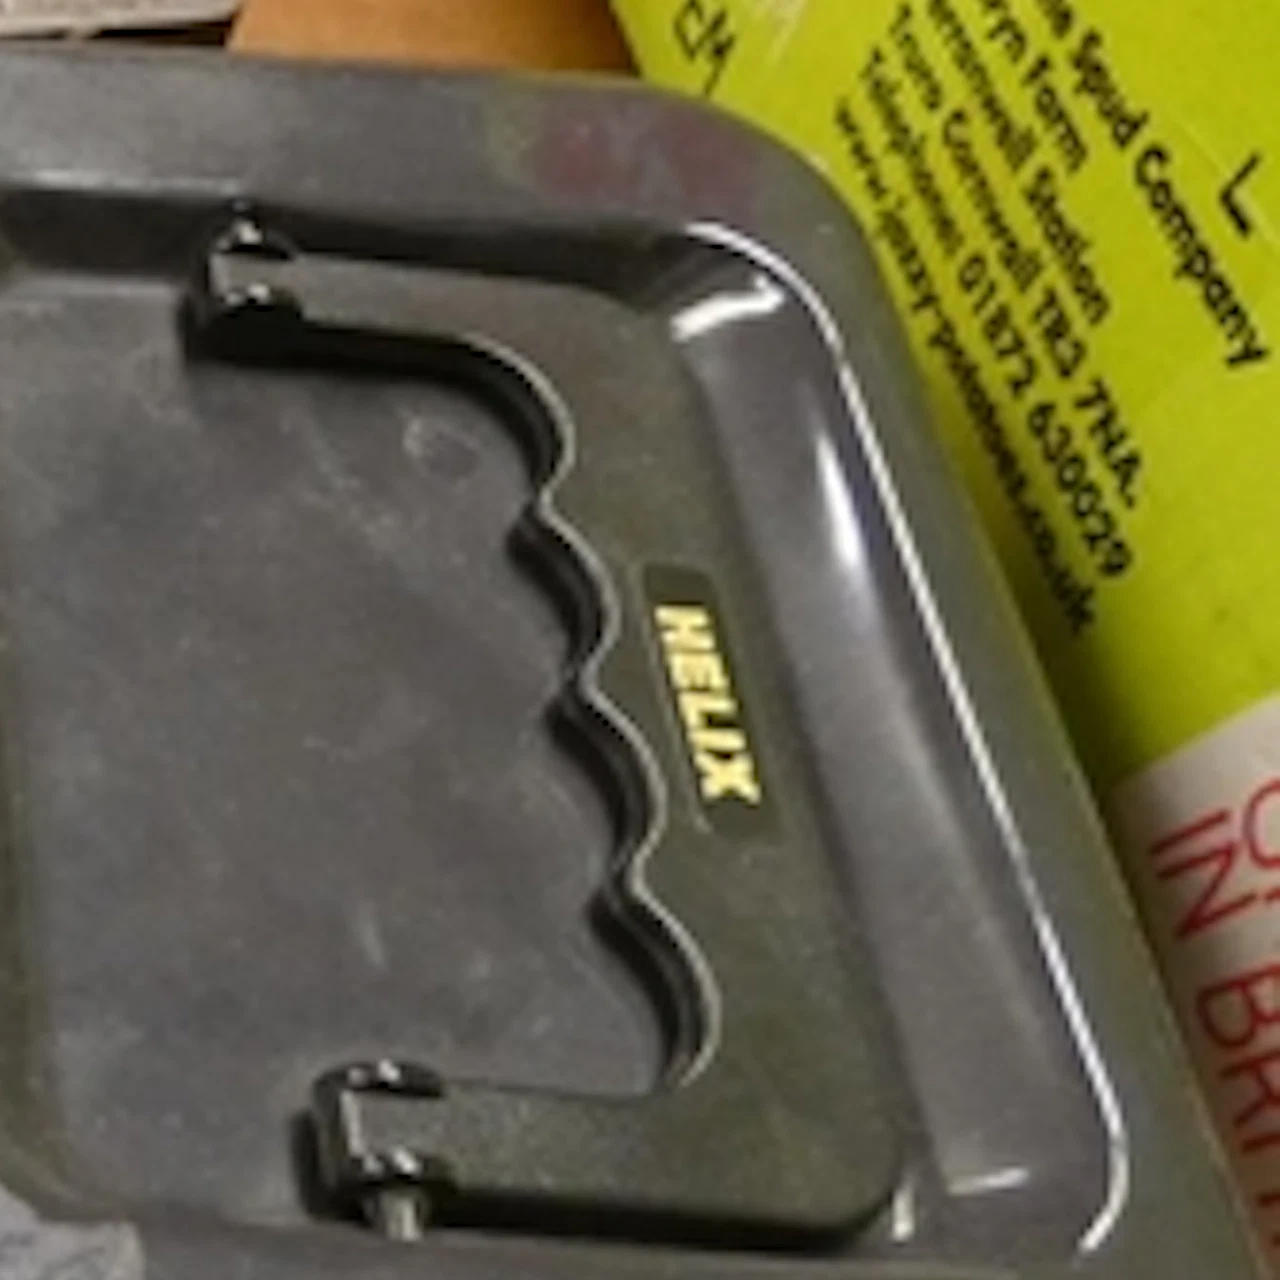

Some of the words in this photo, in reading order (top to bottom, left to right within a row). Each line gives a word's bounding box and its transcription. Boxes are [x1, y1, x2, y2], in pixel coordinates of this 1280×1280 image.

[889, 3, 945, 114] Truro
[942, 109, 1045, 296] Cornwall
[1033, 288, 1087, 381] TR3
[1023, 55, 1089, 173] Farm
[1023, 166, 1111, 327] Station
[1069, 30, 1150, 151] Spud
[1134, 143, 1269, 369] Company
[958, 253, 1040, 402] 01872
[652, 602, 762, 806] HELIX
[1149, 806, 1258, 942] IN
